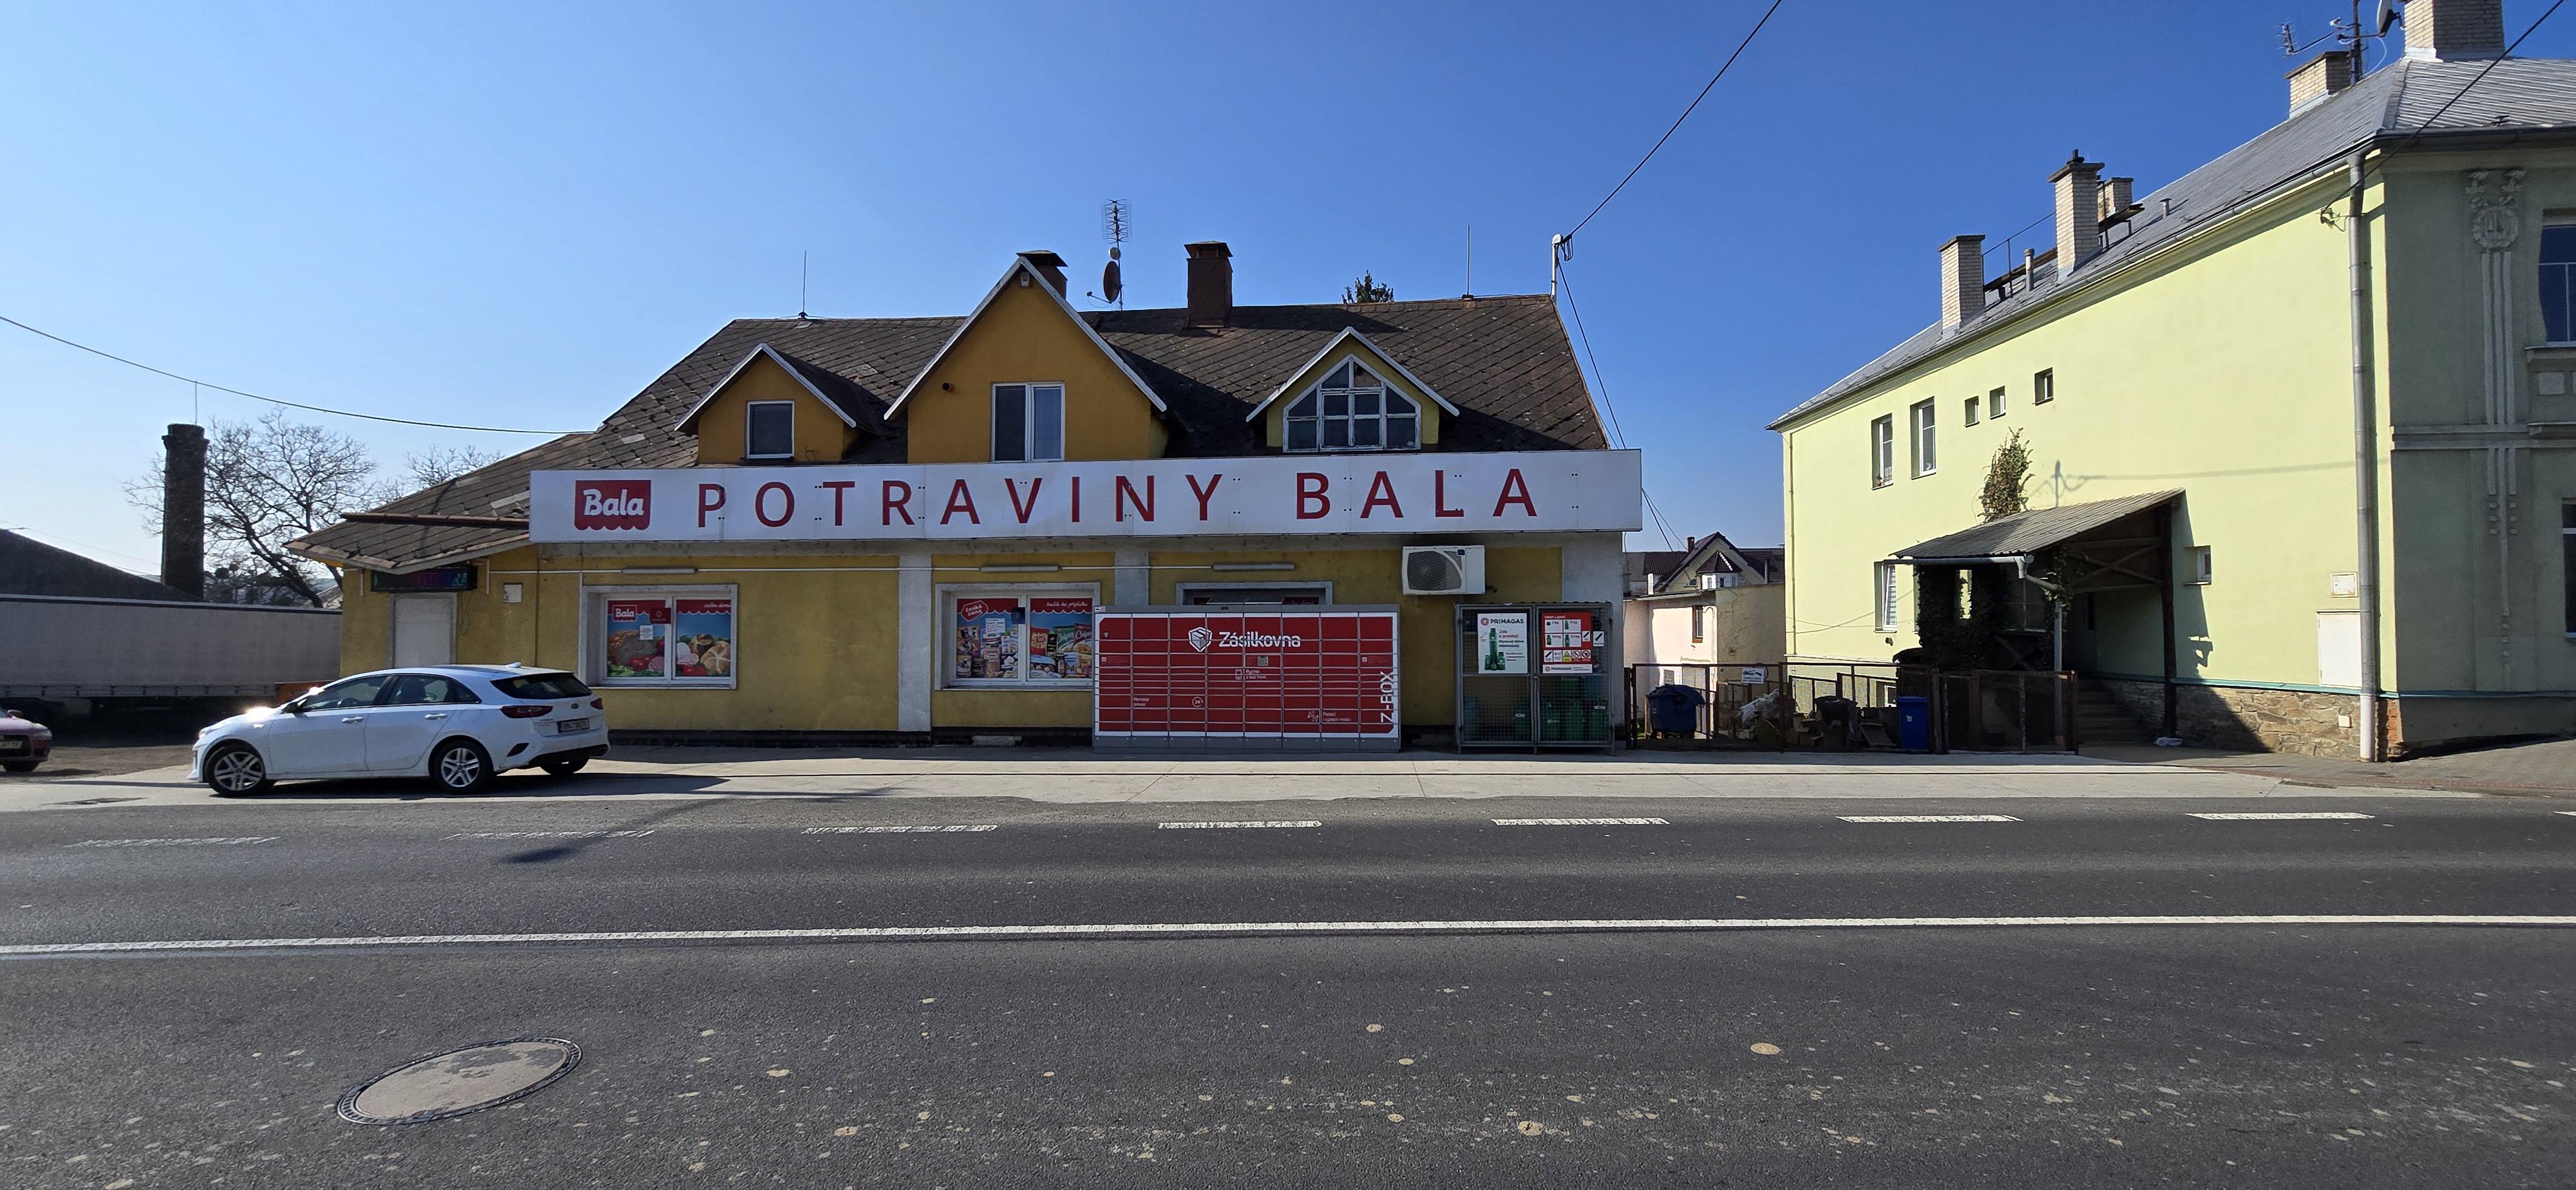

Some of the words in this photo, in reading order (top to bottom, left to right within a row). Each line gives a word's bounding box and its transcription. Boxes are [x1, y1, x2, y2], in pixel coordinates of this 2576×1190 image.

[583, 489, 645, 516] Bala
[697, 474, 1222, 528] POTRAVINY
[1296, 468, 1537, 520] BALA
[615, 608, 635, 618] Bala
[1218, 631, 1301, 648] Zásilkovna
[1380, 671, 1397, 724] Z-BOX
